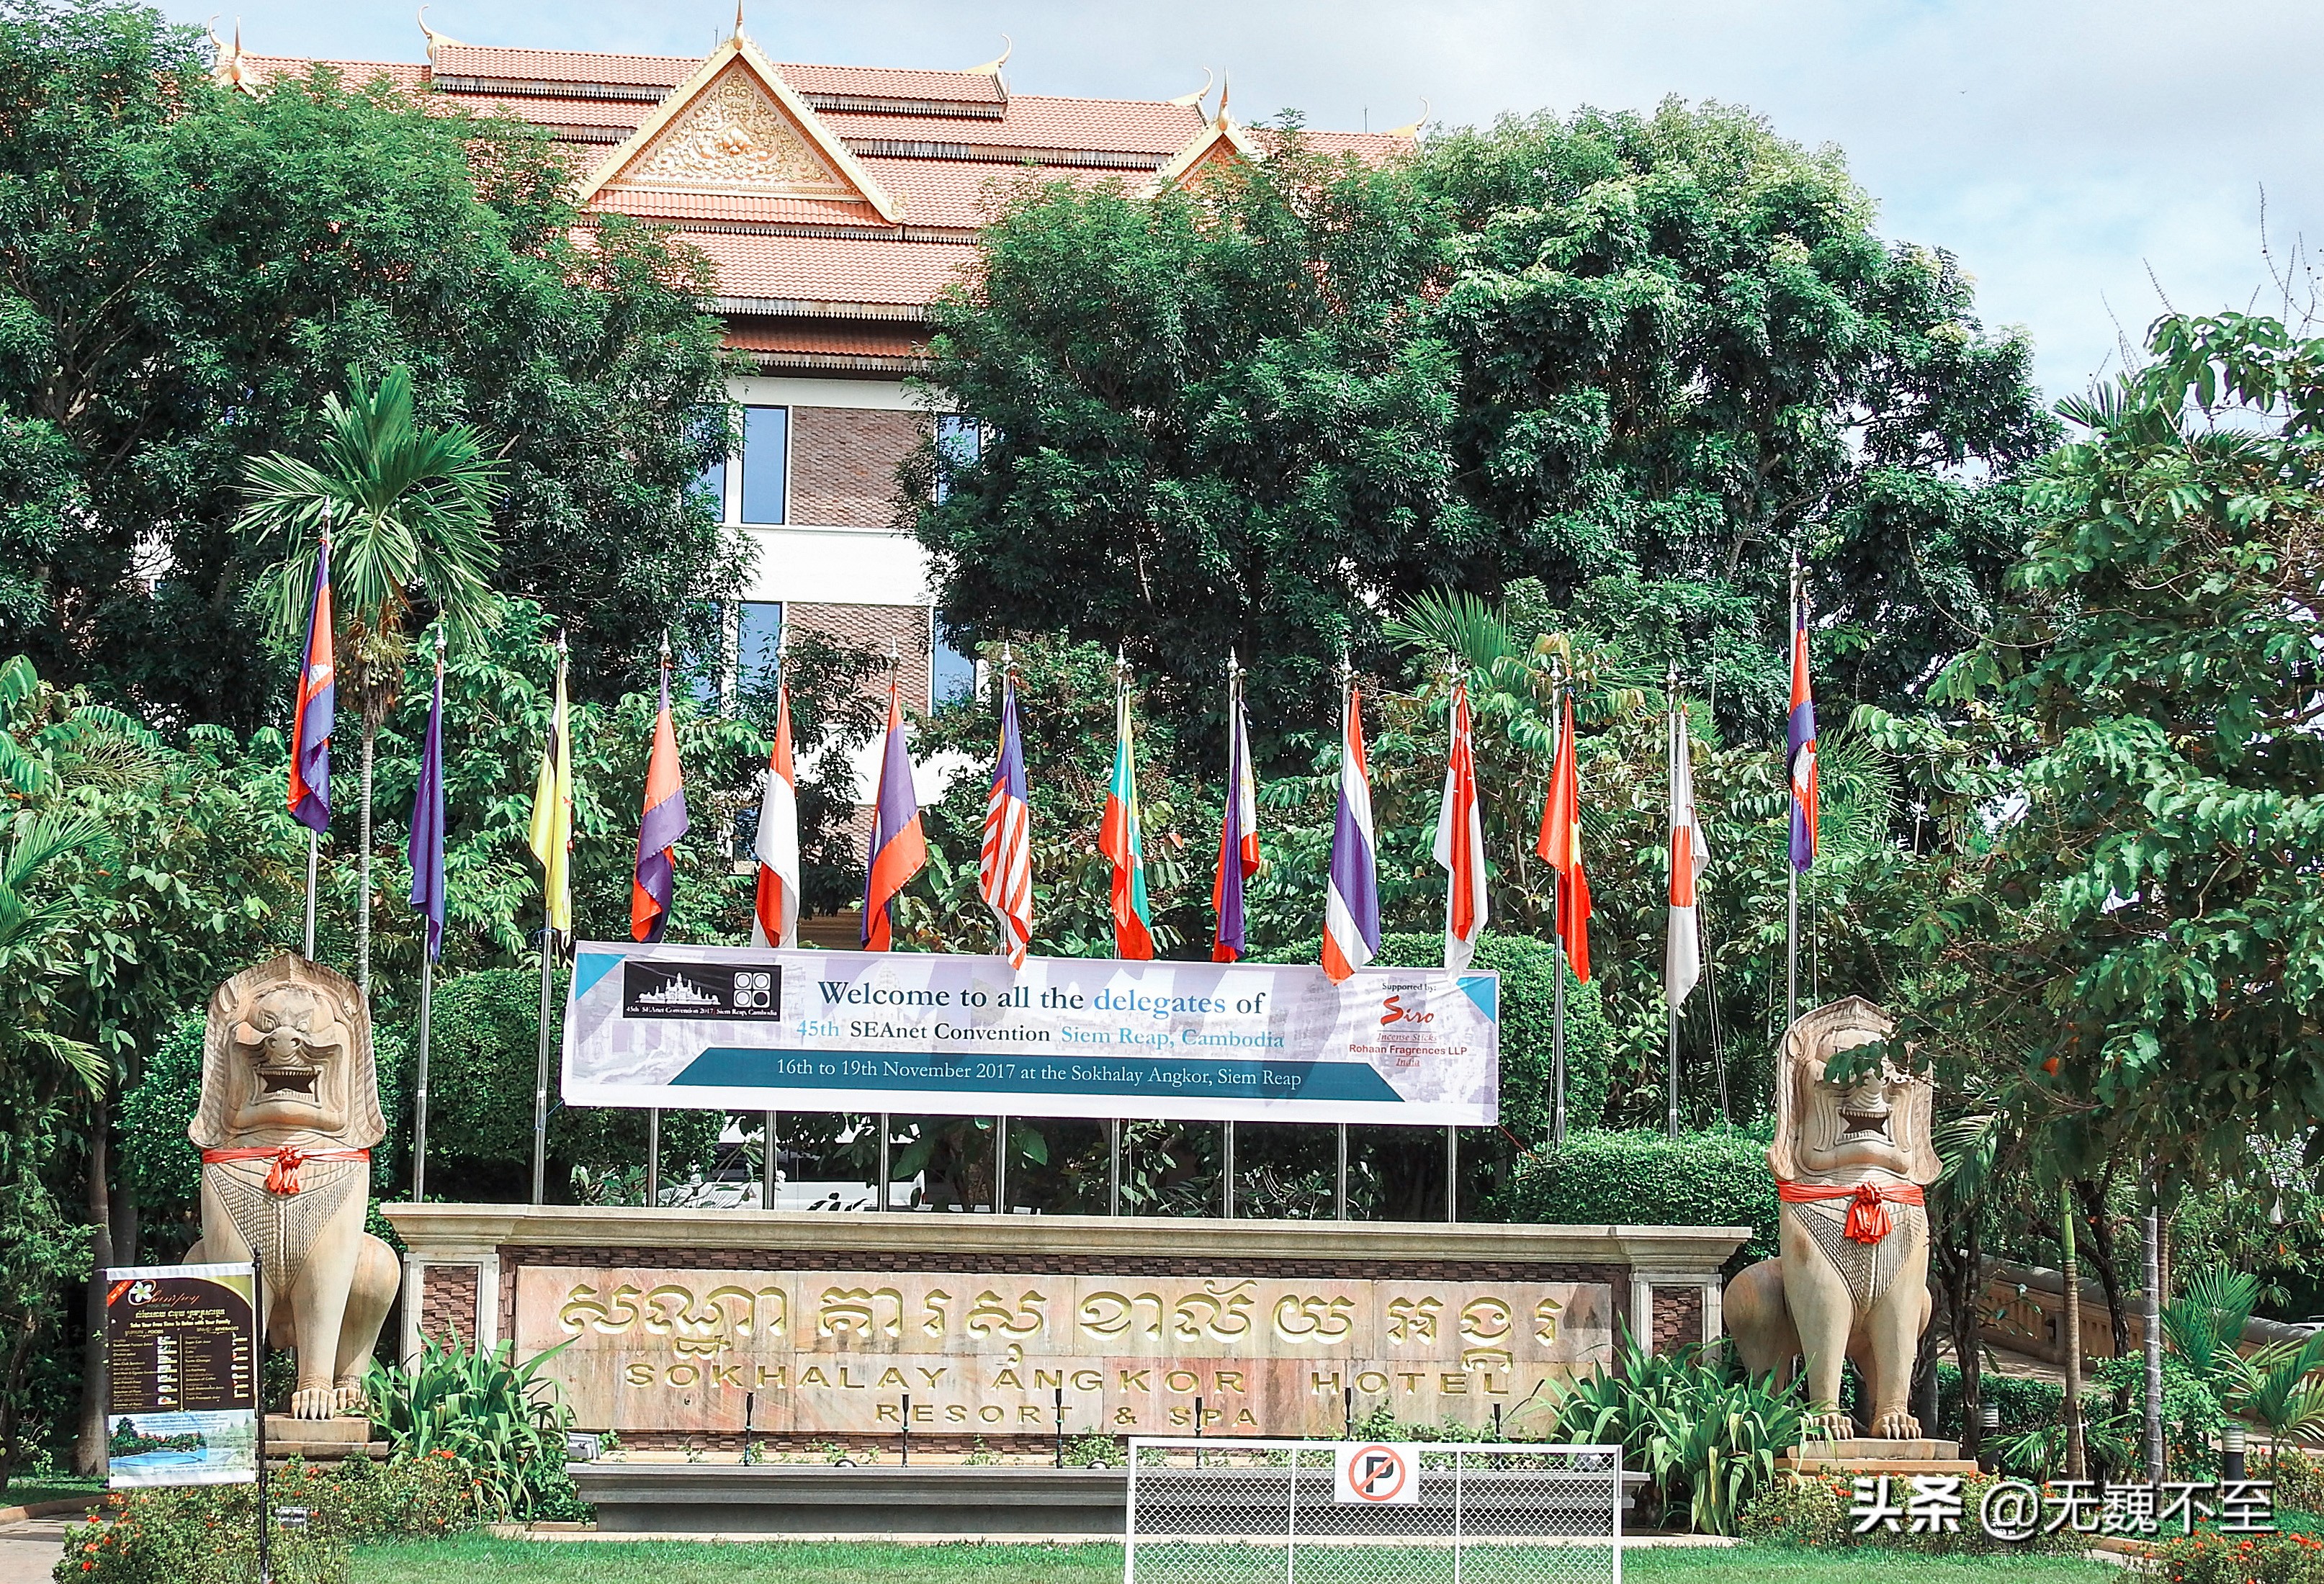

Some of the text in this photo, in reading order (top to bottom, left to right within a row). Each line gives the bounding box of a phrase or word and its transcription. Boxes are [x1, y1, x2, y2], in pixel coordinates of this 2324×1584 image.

[817, 981, 1266, 1020] Welcome to all the delegates of
[1382, 983, 1437, 993] Supported by:
[1381, 994, 1435, 1026] Siro
[796, 1020, 1284, 1050] 45th SEAnet Convention Siem Reap, Cambodia
[1349, 1044, 1467, 1056] Rohaan Fragrences LLP
[778, 1058, 1301, 1090] 16th to 19th November 2017 at the Sokhalay Angkor, Siem Reap
[1396, 1058, 1420, 1066] India
[626, 1363, 1509, 1397] SOKHALAY ANGKOR HOTEL
[876, 1404, 1259, 1427] RESORT & SPA
[1366, 1457, 1394, 1493] P
